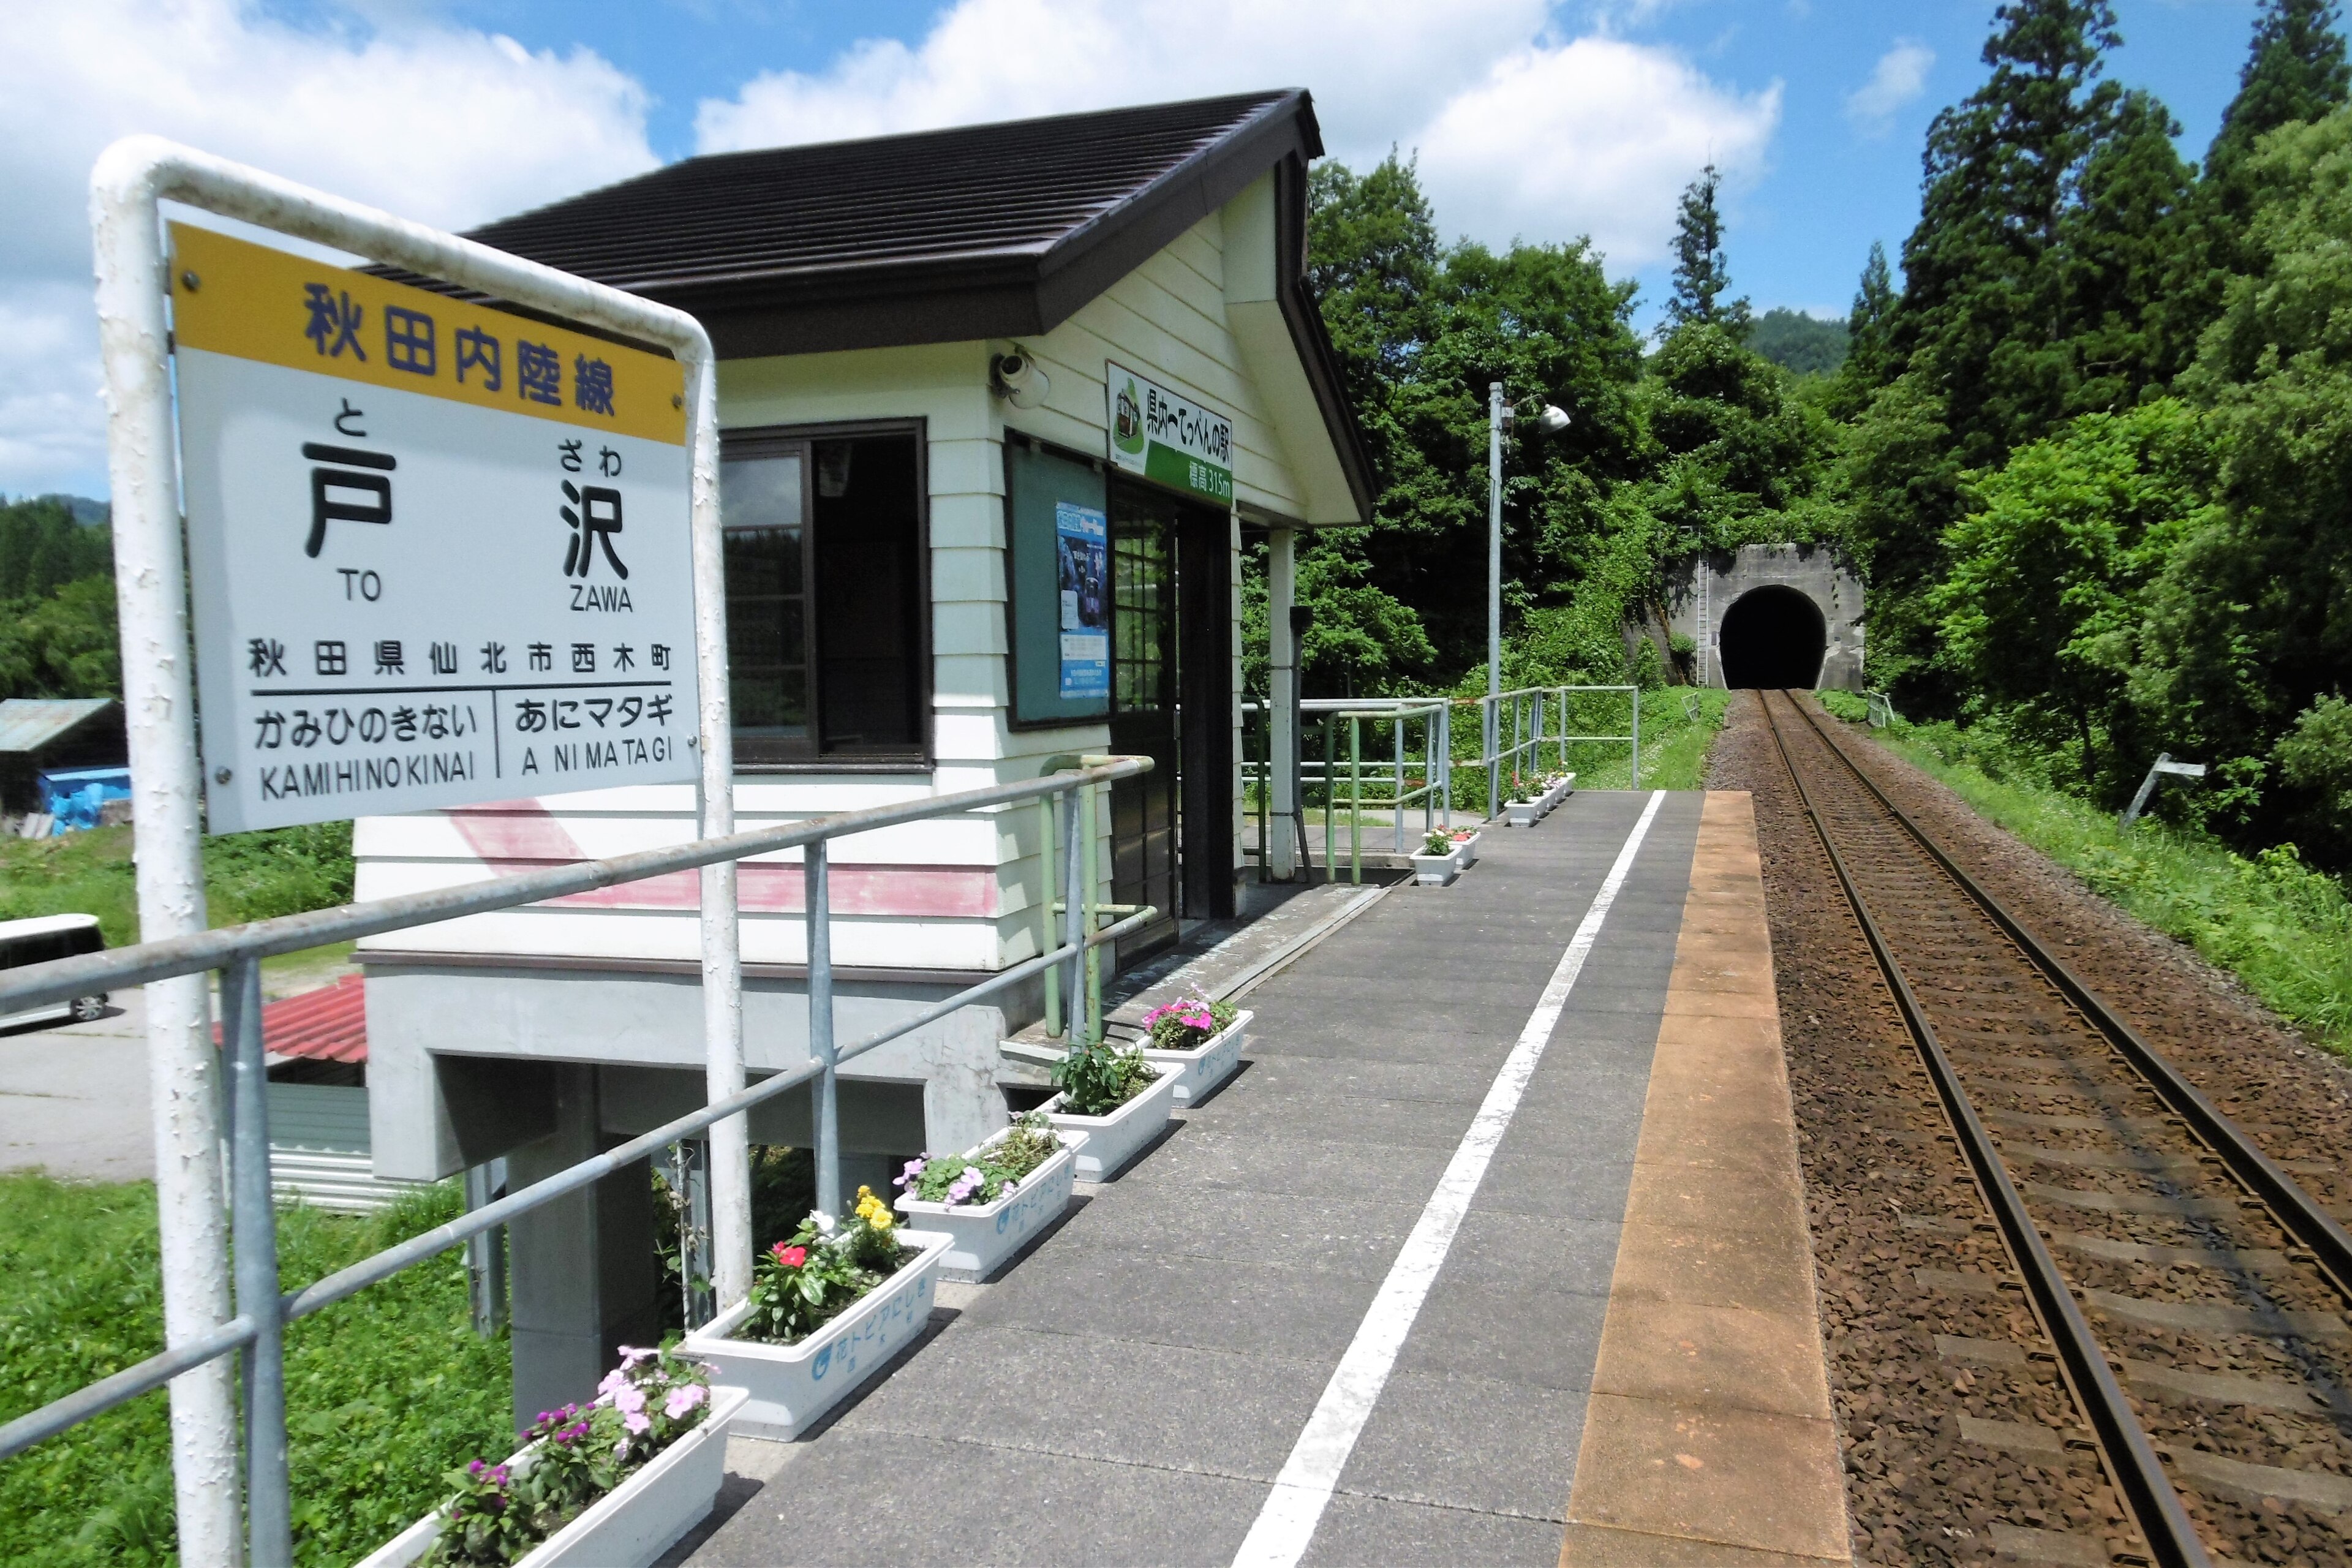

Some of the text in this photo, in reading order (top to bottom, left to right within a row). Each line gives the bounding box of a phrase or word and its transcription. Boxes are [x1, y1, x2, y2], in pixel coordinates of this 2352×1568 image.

[304, 282, 615, 417] 秋田内陸線
[334, 398, 366, 437] と
[1147, 388, 1230, 464] 県内一てっぺんの駅
[301, 440, 629, 581] 戸 沢
[337, 568, 634, 614] TO ZAWA
[247, 637, 672, 677] 秋田県仙北市西木町
[254, 704, 477, 750] かみひのきない
[515, 692, 674, 733] あにマタギ
